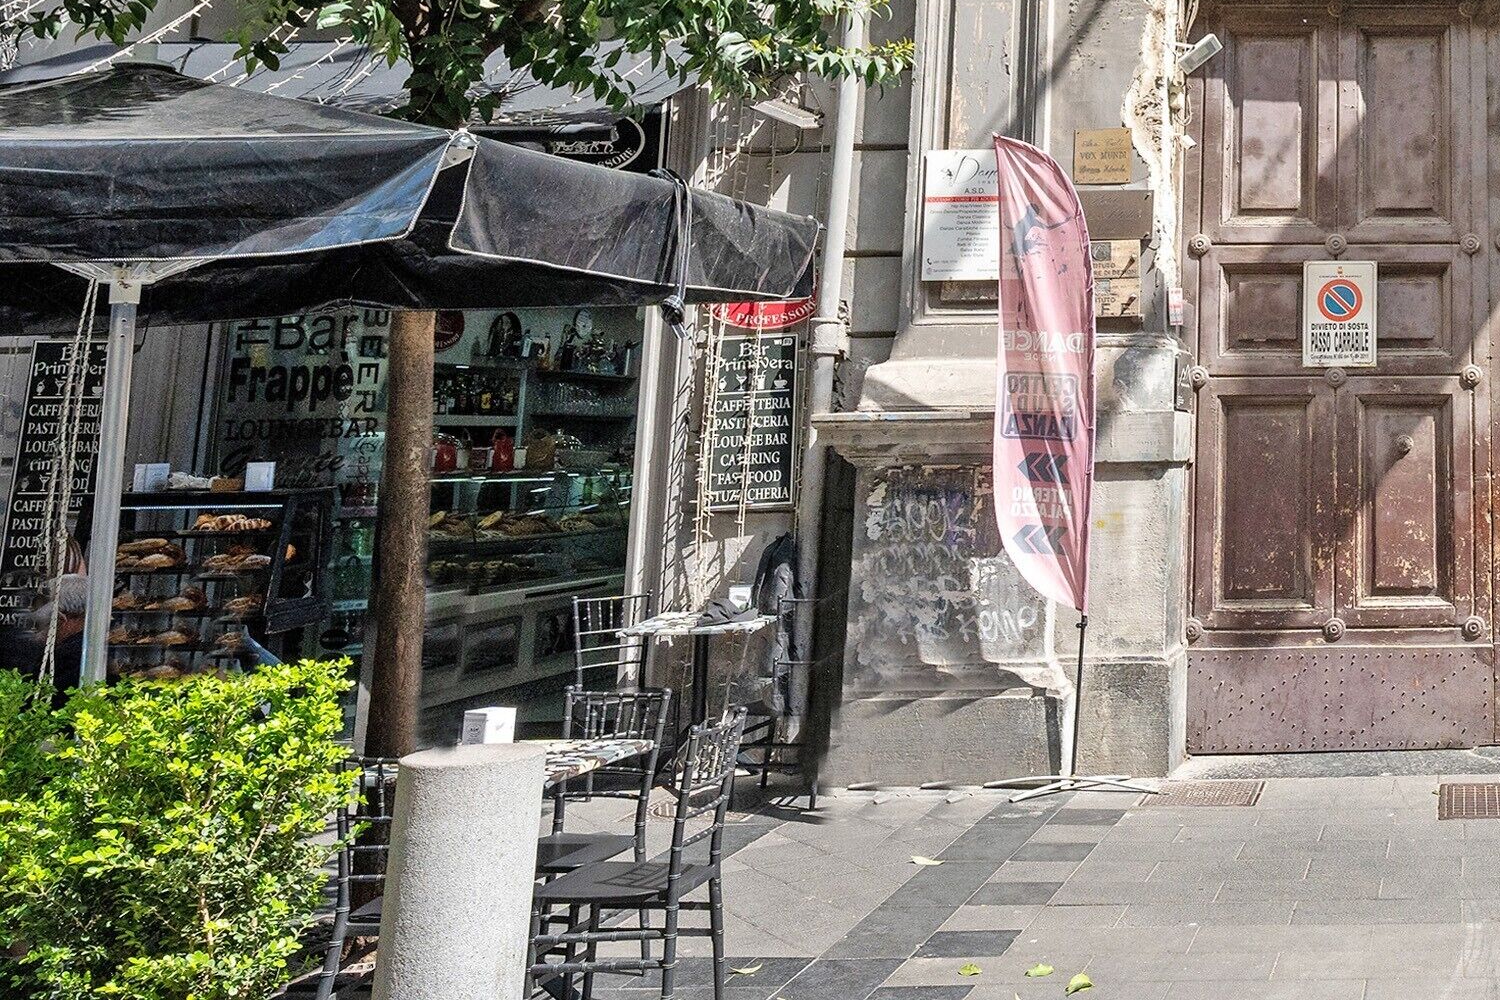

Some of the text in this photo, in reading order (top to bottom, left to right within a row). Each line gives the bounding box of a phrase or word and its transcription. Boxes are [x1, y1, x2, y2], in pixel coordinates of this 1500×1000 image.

[274, 313, 360, 350] Bar
[1347, 322, 1369, 330] SOSTA
[738, 342, 769, 357] Bar
[713, 415, 789, 431] PASTICERIA
[765, 432, 788, 446] BAR
[746, 469, 782, 484] FOOD
